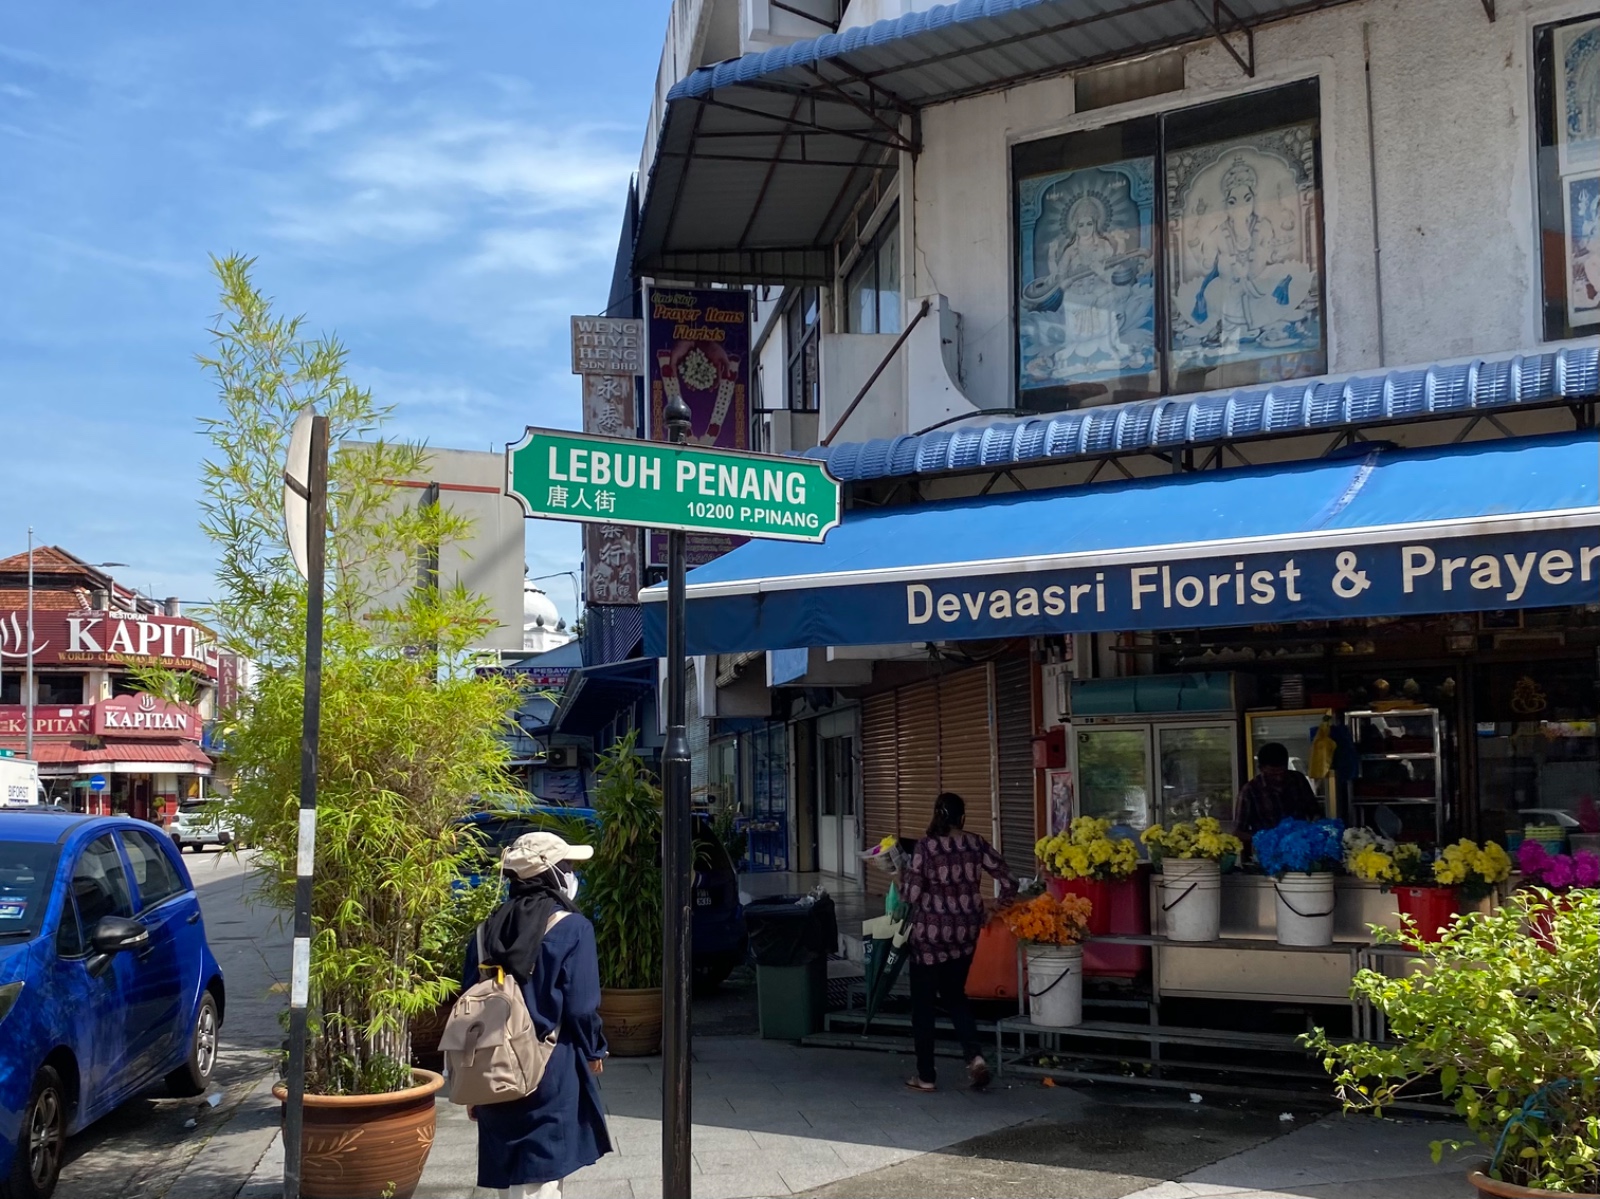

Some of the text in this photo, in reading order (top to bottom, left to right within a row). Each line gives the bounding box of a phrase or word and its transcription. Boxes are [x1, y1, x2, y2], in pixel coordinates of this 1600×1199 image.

[654, 304, 745, 324] Prayer Items
[577, 321, 637, 334] WENG
[673, 325, 726, 342] Florists
[578, 334, 636, 348] THYE
[578, 347, 637, 360] HENG
[579, 361, 605, 369] SDN
[547, 446, 806, 505] LEBUH PENANG
[546, 484, 617, 513] 唐人街
[687, 501, 819, 528] 10200 P.PINANG
[907, 545, 1600, 625] Devaasri Florist & Prayer
[109, 611, 148, 621] RESTORAN
[59, 652, 94, 661] WORLD
[105, 711, 187, 729] KAPITAN
